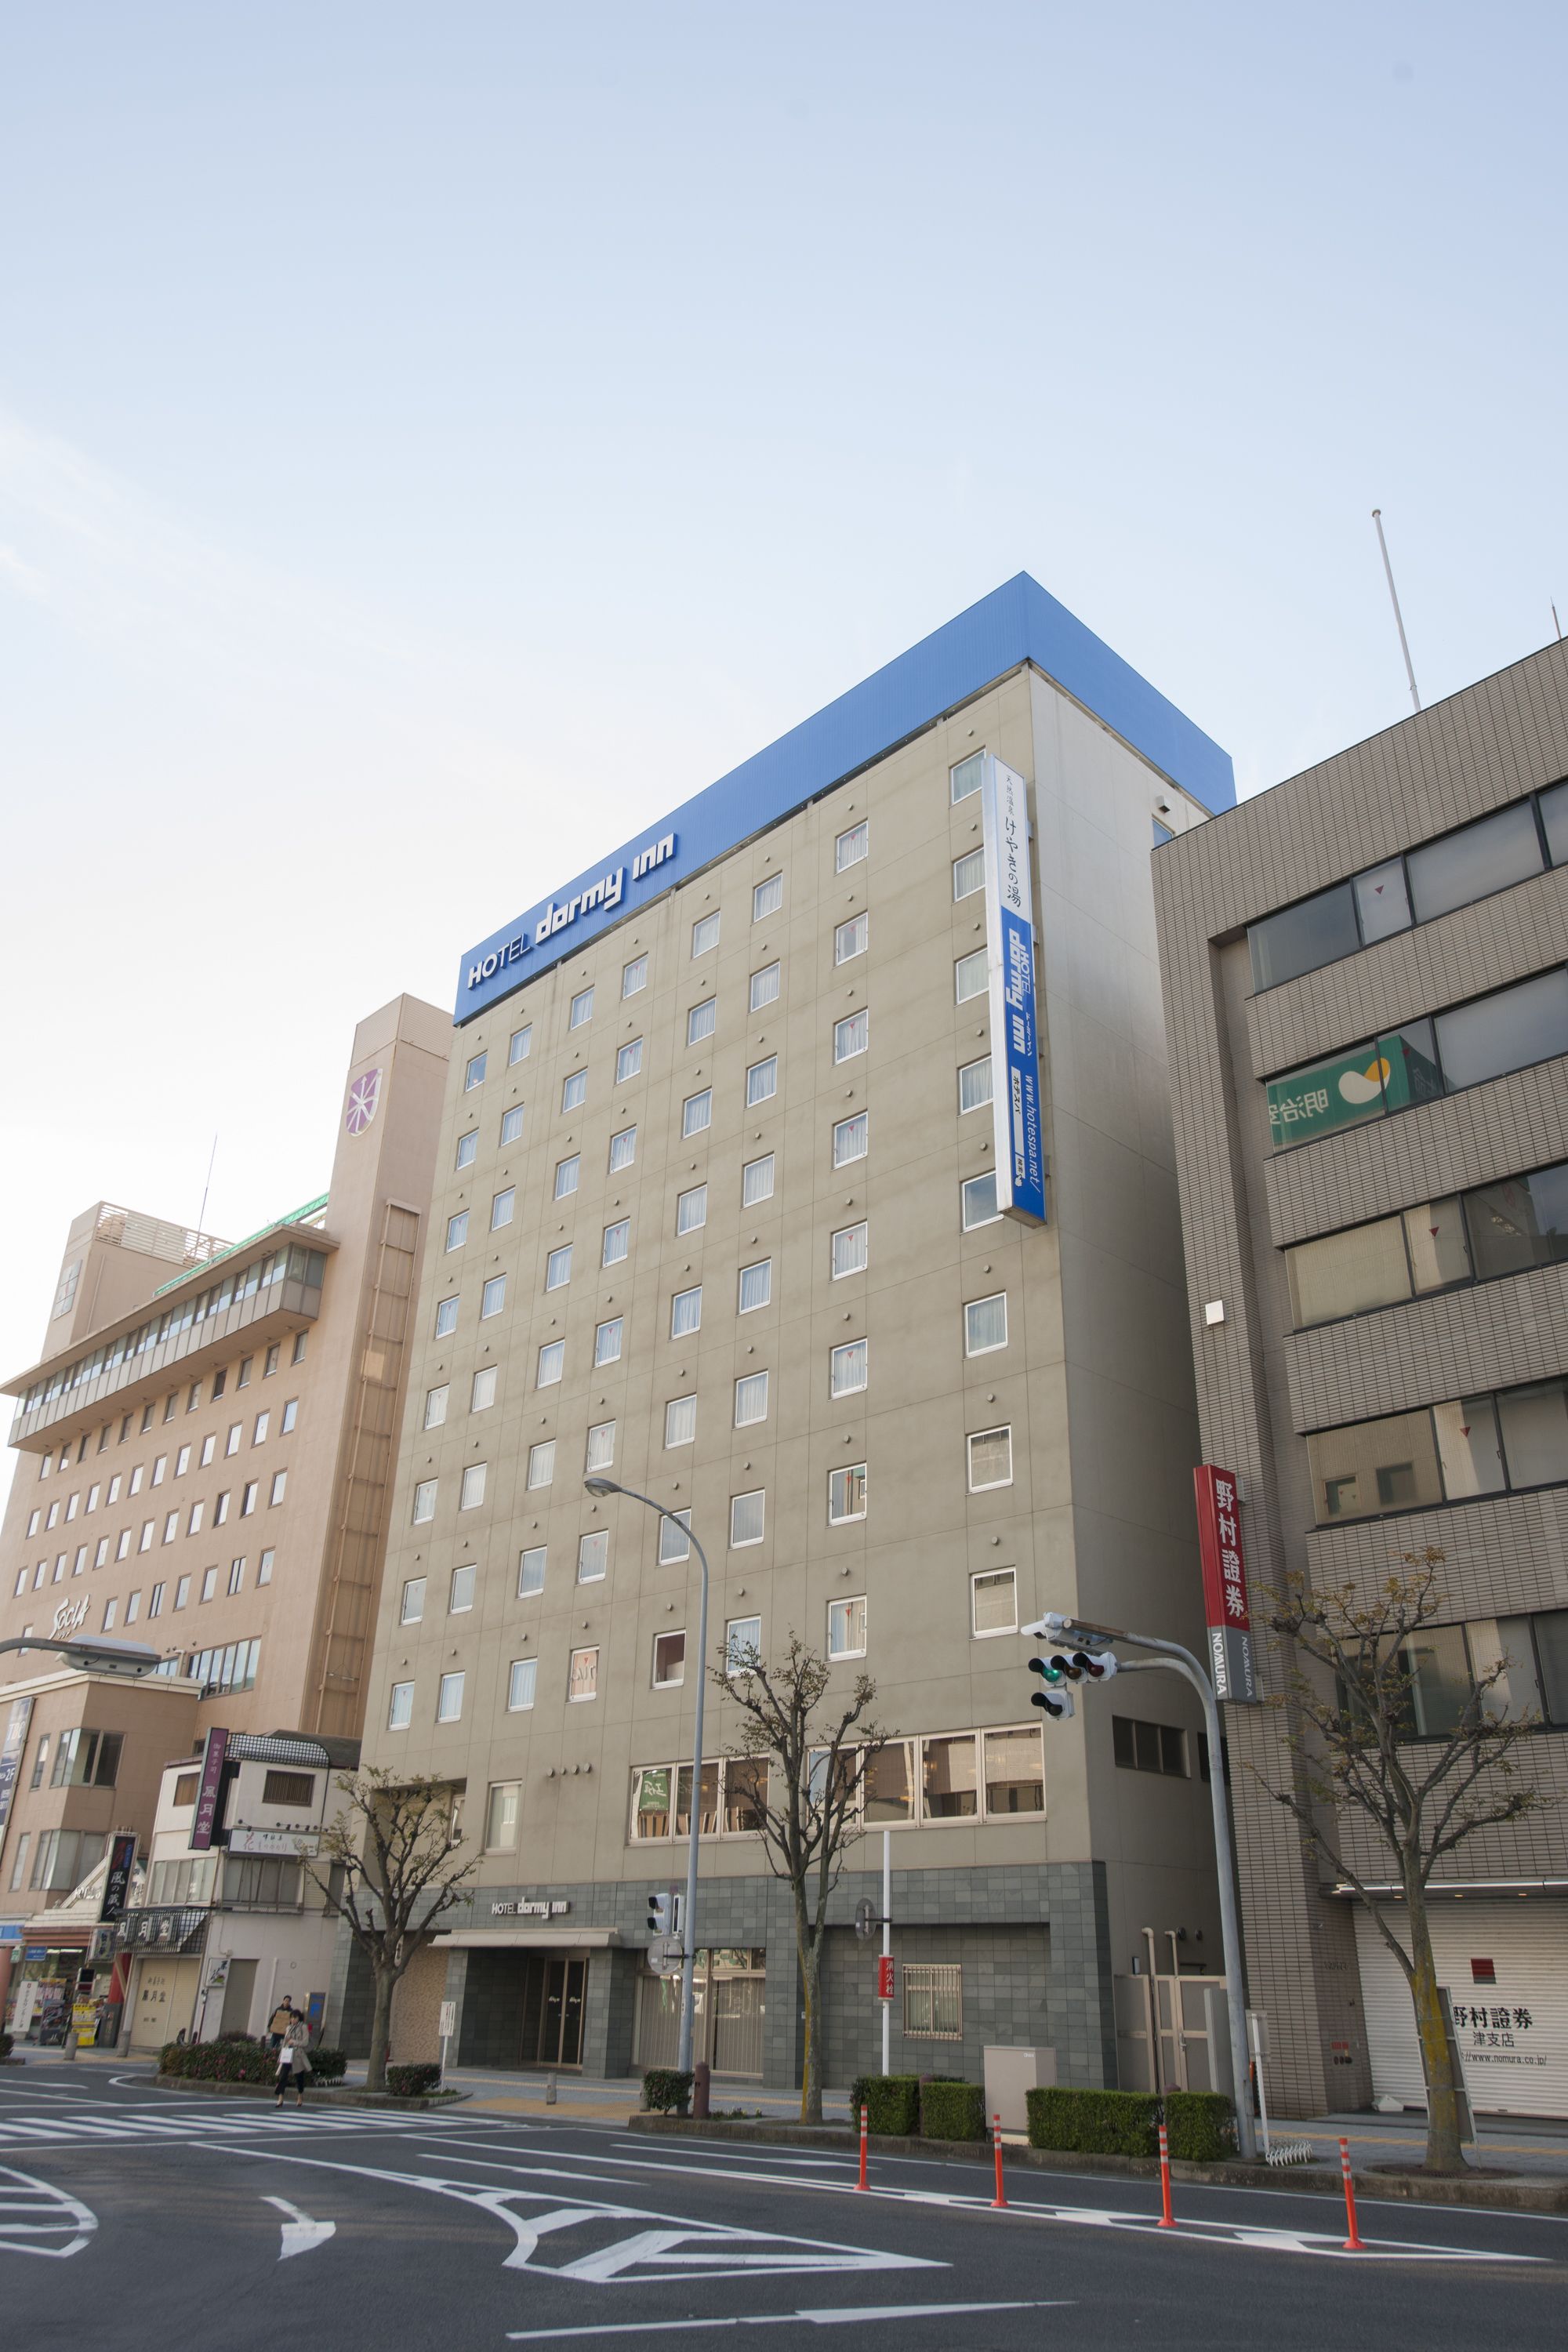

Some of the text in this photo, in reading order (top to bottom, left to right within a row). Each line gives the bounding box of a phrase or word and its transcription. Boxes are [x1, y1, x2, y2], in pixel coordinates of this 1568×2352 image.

[1005, 816, 1021, 907] けやきの湯
[467, 833, 677, 989] HOTEL dormy inn
[1006, 927, 1026, 1054] dormy inn
[1019, 949, 1031, 995] HOTEL
[1025, 1075, 1041, 1193] www.hotespa.net/
[1215, 1478, 1244, 1617] 野村證券
[1212, 1632, 1227, 1695] NOMURA
[1241, 1636, 1253, 1698] NOMURA
[492, 1896, 568, 1919] HOTEL dormy inn
[1453, 2005, 1533, 2030] 野村證券
[1473, 2031, 1515, 2047] 津支店
